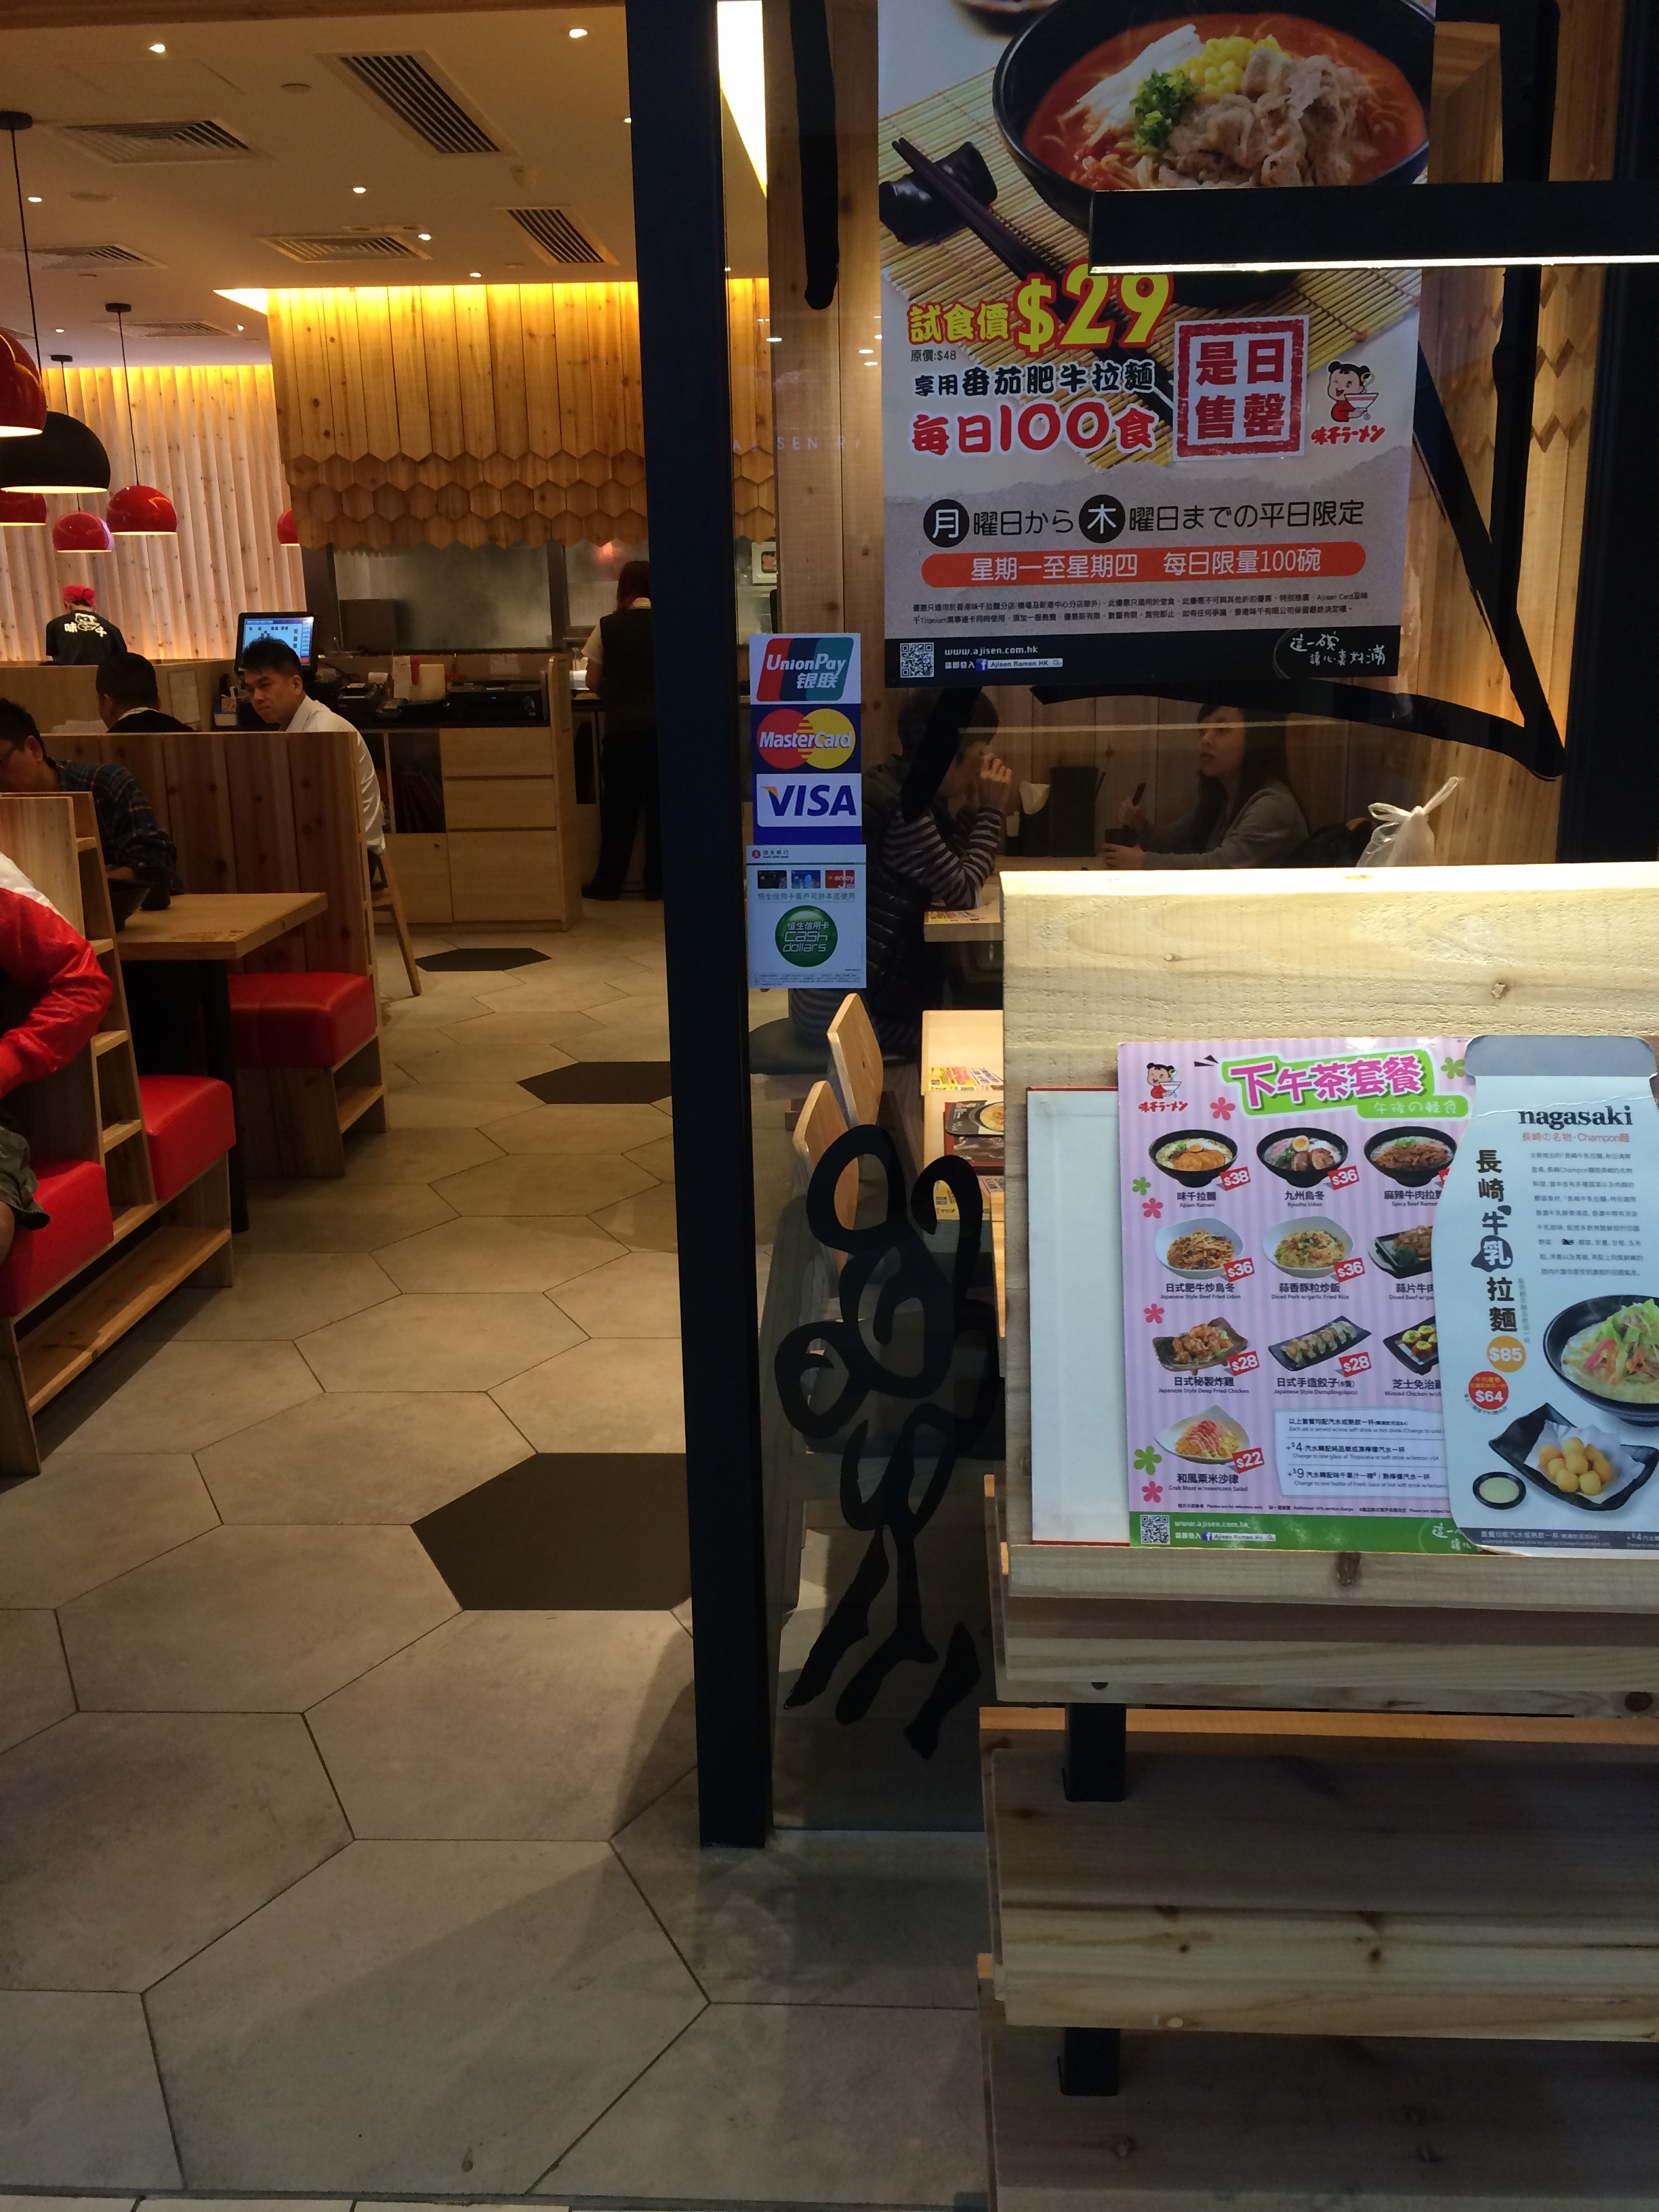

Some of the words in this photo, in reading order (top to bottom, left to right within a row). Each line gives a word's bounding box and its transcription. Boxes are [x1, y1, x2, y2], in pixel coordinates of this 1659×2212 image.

[909, 302, 1010, 344] 試食價
[1012, 257, 1176, 357] $29
[1195, 337, 1286, 386] 是日
[914, 359, 1155, 397] 享用番茄肥牛拉麵
[1195, 393, 1286, 441] 售罄
[911, 399, 1158, 455] 每日100食
[971, 552, 1138, 582] 星期一至星期四
[1164, 548, 1321, 576] 每日限量100碗
[944, 646, 1039, 657] www.ajisen.com.hk
[766, 653, 847, 676] UnionPay
[796, 672, 839, 689] 银联
[759, 731, 853, 748] MasterCard
[760, 784, 857, 817] VISA
[1230, 1054, 1425, 1109] 下午茶套餐
[1518, 1105, 1633, 1130] nagasaki
[1223, 1170, 1250, 1187] $38
[1332, 1169, 1359, 1186] $36
[1227, 1261, 1254, 1278] $36
[1337, 1261, 1364, 1278] $36
[1231, 1354, 1258, 1372] $28
[1489, 1347, 1523, 1362] $85
[1343, 1355, 1371, 1373] $28
[1475, 1389, 1504, 1404] $64
[1236, 1451, 1263, 1469] $22
